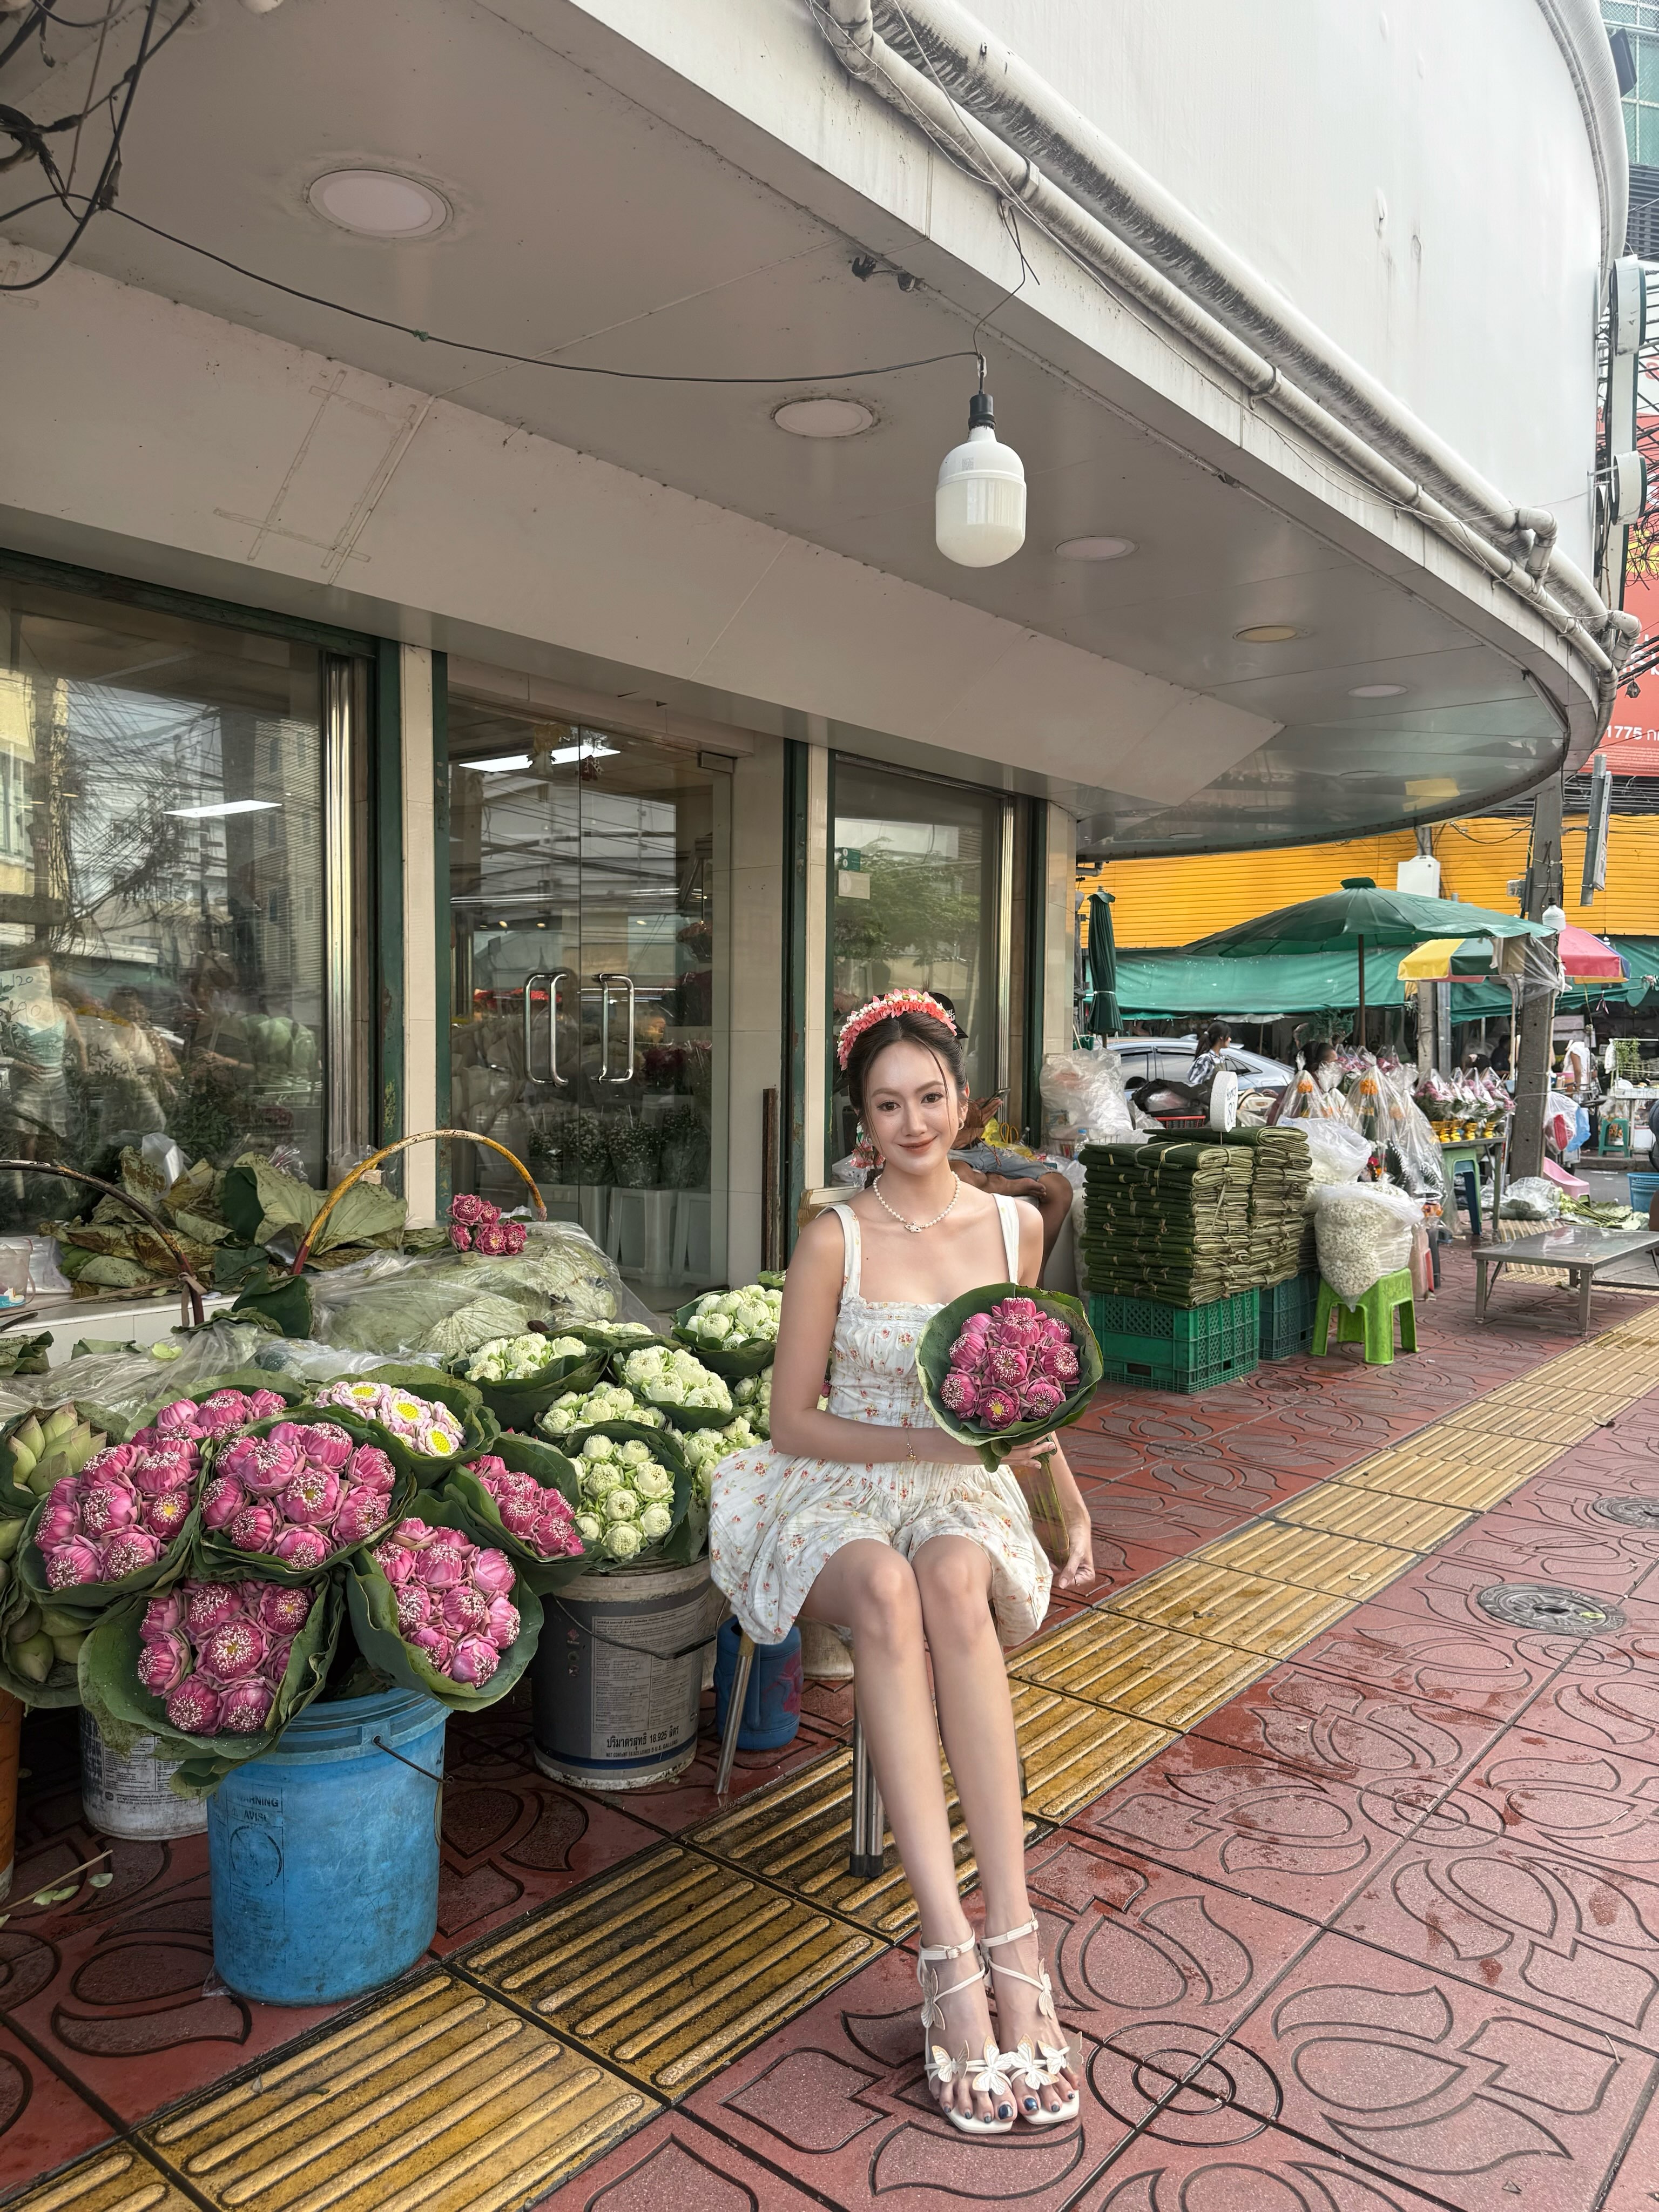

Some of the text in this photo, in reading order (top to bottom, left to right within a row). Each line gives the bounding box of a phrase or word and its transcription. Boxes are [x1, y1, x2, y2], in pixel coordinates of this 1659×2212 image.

[1607, 725, 1642, 740] 1775
[606, 1732, 647, 1750] ปริมาตรสุทธิ
[650, 1730, 667, 1743] 18.925
